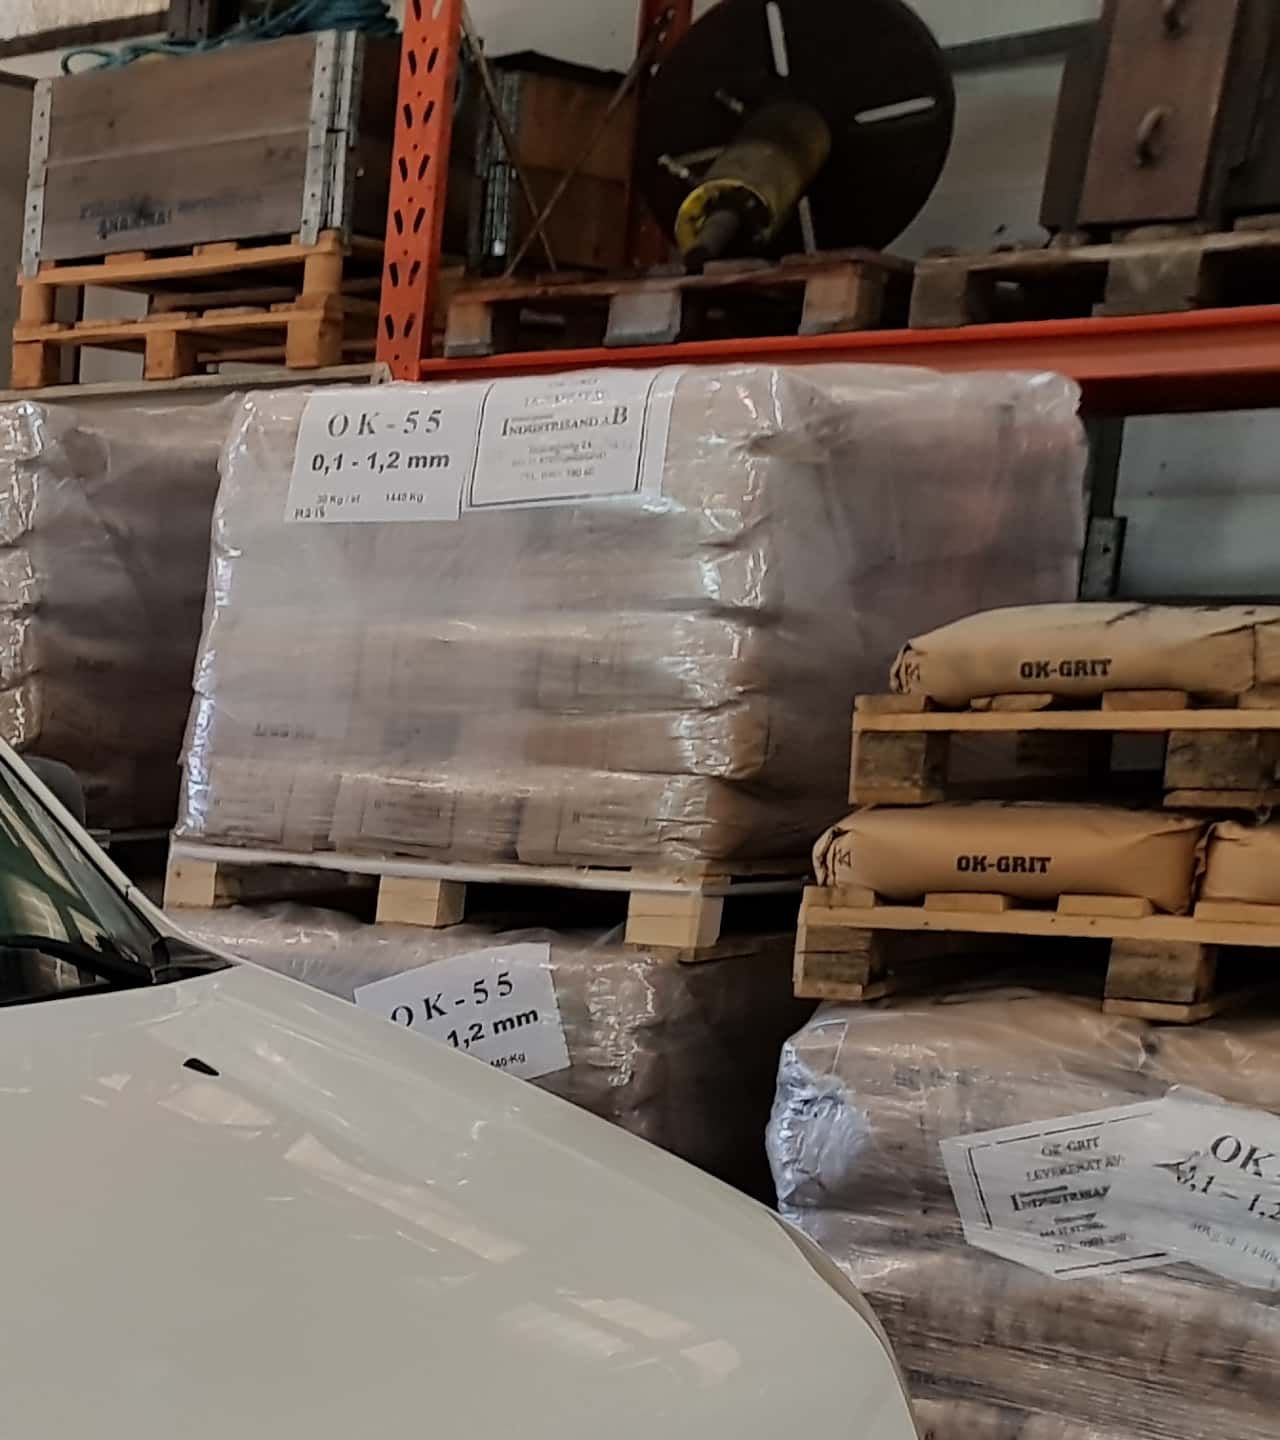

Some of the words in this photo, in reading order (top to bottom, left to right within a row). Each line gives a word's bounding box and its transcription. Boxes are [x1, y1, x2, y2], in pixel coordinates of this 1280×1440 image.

[311, 453, 344, 476] 0,1
[367, 451, 401, 475] 1,2
[407, 453, 450, 469] mm
[1020, 659, 1112, 679] OK-GRIT
[956, 855, 1052, 873] OK-GRIT
[447, 1020, 485, 1049] 1,2
[493, 1009, 539, 1035] mm
